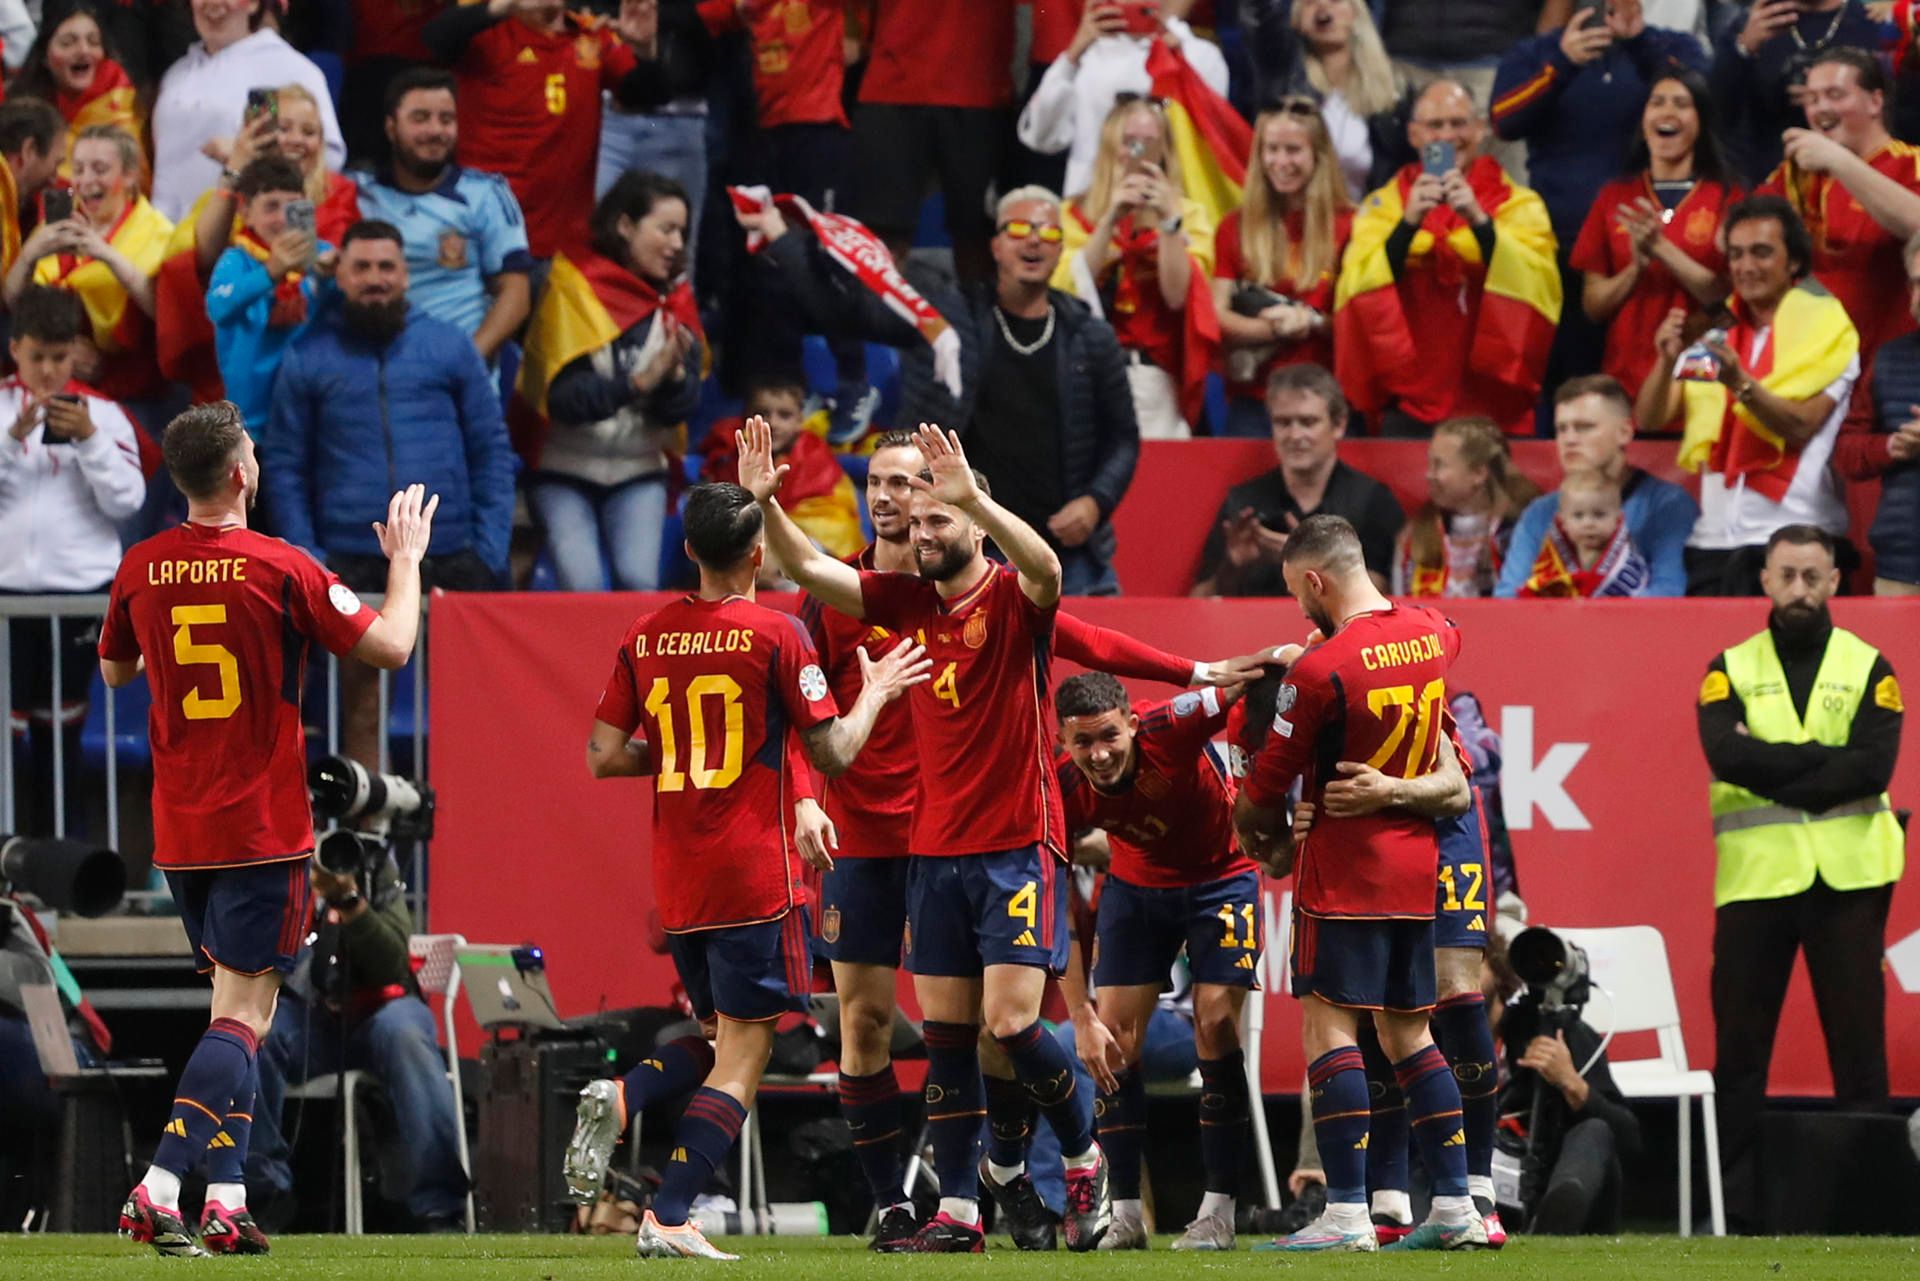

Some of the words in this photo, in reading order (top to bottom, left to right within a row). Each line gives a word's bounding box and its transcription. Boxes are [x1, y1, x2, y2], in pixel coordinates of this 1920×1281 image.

[545, 73, 566, 114] 5
[148, 558, 248, 586] LAPORTE
[171, 604, 242, 720] 5
[635, 633, 650, 659] D.
[656, 629, 753, 656] CEBALLOS
[1360, 633, 1444, 671] CARVAJAL
[932, 661, 961, 708] 4
[644, 674, 744, 793] 10
[1366, 677, 1445, 780] 20
[1007, 881, 1037, 928] 4
[1438, 862, 1486, 911] 12
[1219, 902, 1257, 950] 11
